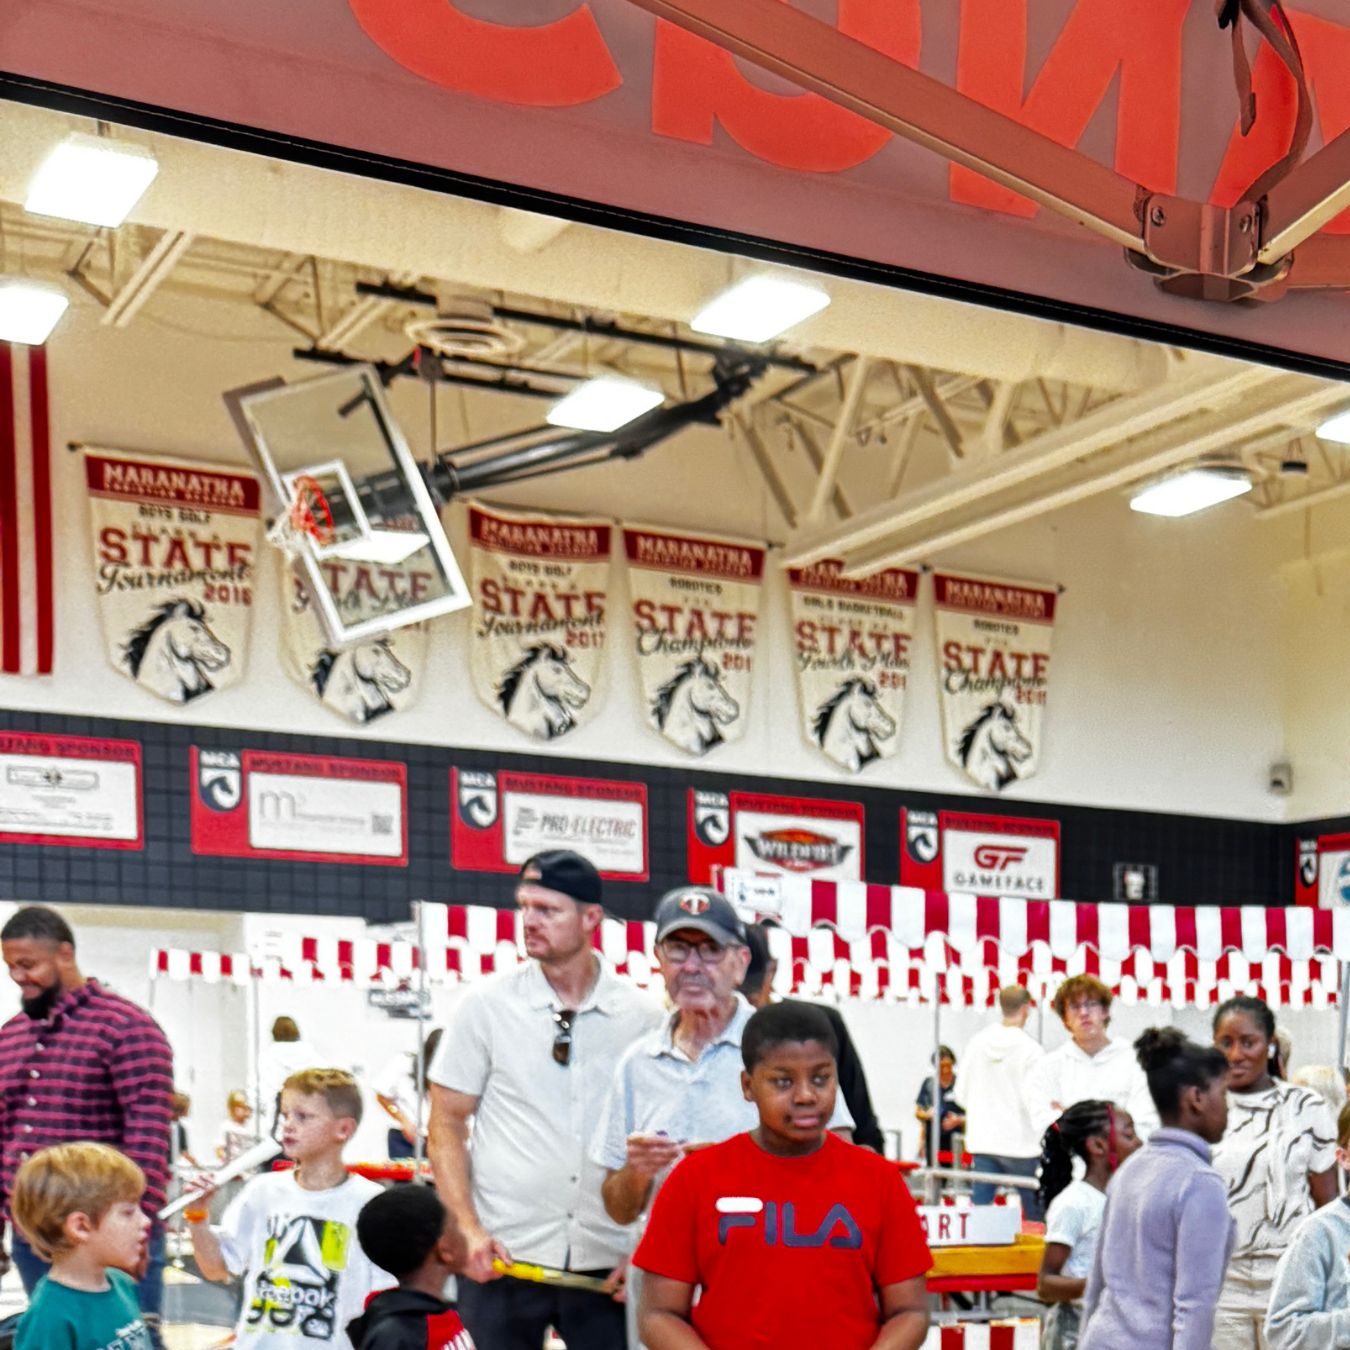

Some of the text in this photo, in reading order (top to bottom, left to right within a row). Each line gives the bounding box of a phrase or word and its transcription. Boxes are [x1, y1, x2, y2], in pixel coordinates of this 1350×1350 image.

[103, 462, 245, 497] MARANATHA
[100, 527, 252, 571] STATE
[480, 577, 606, 620] STATE
[634, 599, 757, 640] STATE
[796, 620, 912, 661] STATE
[943, 640, 1050, 681] STATE
[954, 871, 1044, 893] GAMEFACE
[715, 1196, 863, 1250] FILA
